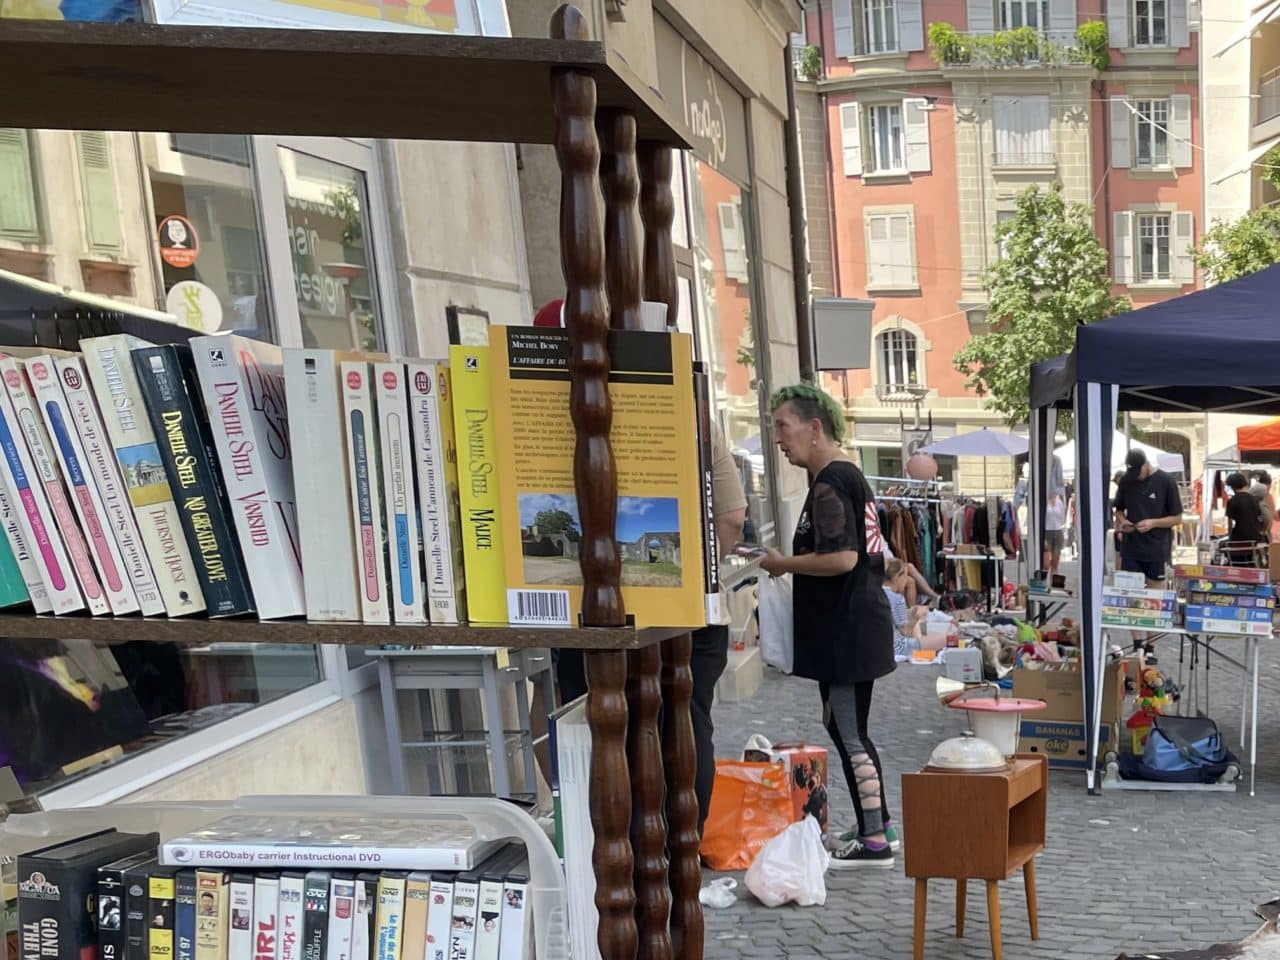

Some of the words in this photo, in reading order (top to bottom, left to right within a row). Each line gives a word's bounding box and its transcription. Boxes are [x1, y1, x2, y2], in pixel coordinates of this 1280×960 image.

[512, 341, 539, 350] MICHEL
[98, 347, 123, 396] DANIELLE
[114, 396, 137, 433] STEEL
[73, 400, 90, 425] rêve
[214, 380, 244, 437] DANIELLE
[417, 399, 432, 450] Cassandra
[82, 426, 95, 442] de
[162, 409, 185, 456] DANIELLE
[465, 409, 489, 460] DANIELLE
[88, 442, 110, 482] monde
[174, 455, 198, 489] STEEL
[228, 440, 255, 482] STEEL
[423, 453, 433, 466] de
[468, 460, 492, 498] STEEL
[24, 494, 36, 514] Steel
[184, 495, 205, 512] NO
[237, 490, 270, 547] VANISHED
[6, 518, 29, 562] Danielle
[31, 513, 49, 546] Danielle
[192, 511, 215, 553] GREATER
[363, 528, 372, 546] Steel
[470, 507, 494, 551] MALICE
[120, 532, 145, 579] Danielle
[203, 550, 226, 583] LOVE
[365, 549, 375, 578] Danielle
[430, 544, 444, 584] Danielle
[707, 522, 716, 583] Nicolas
[199, 850, 254, 861] ERGObaby
[257, 852, 291, 862] carrier
[293, 852, 356, 862] Instructional
[358, 853, 381, 863] DVD
[21, 921, 40, 950] THE
[39, 918, 59, 957] GONE
[284, 915, 295, 927] Le
[180, 936, 190, 948] 97
[311, 928, 322, 960] SOUFFLE
